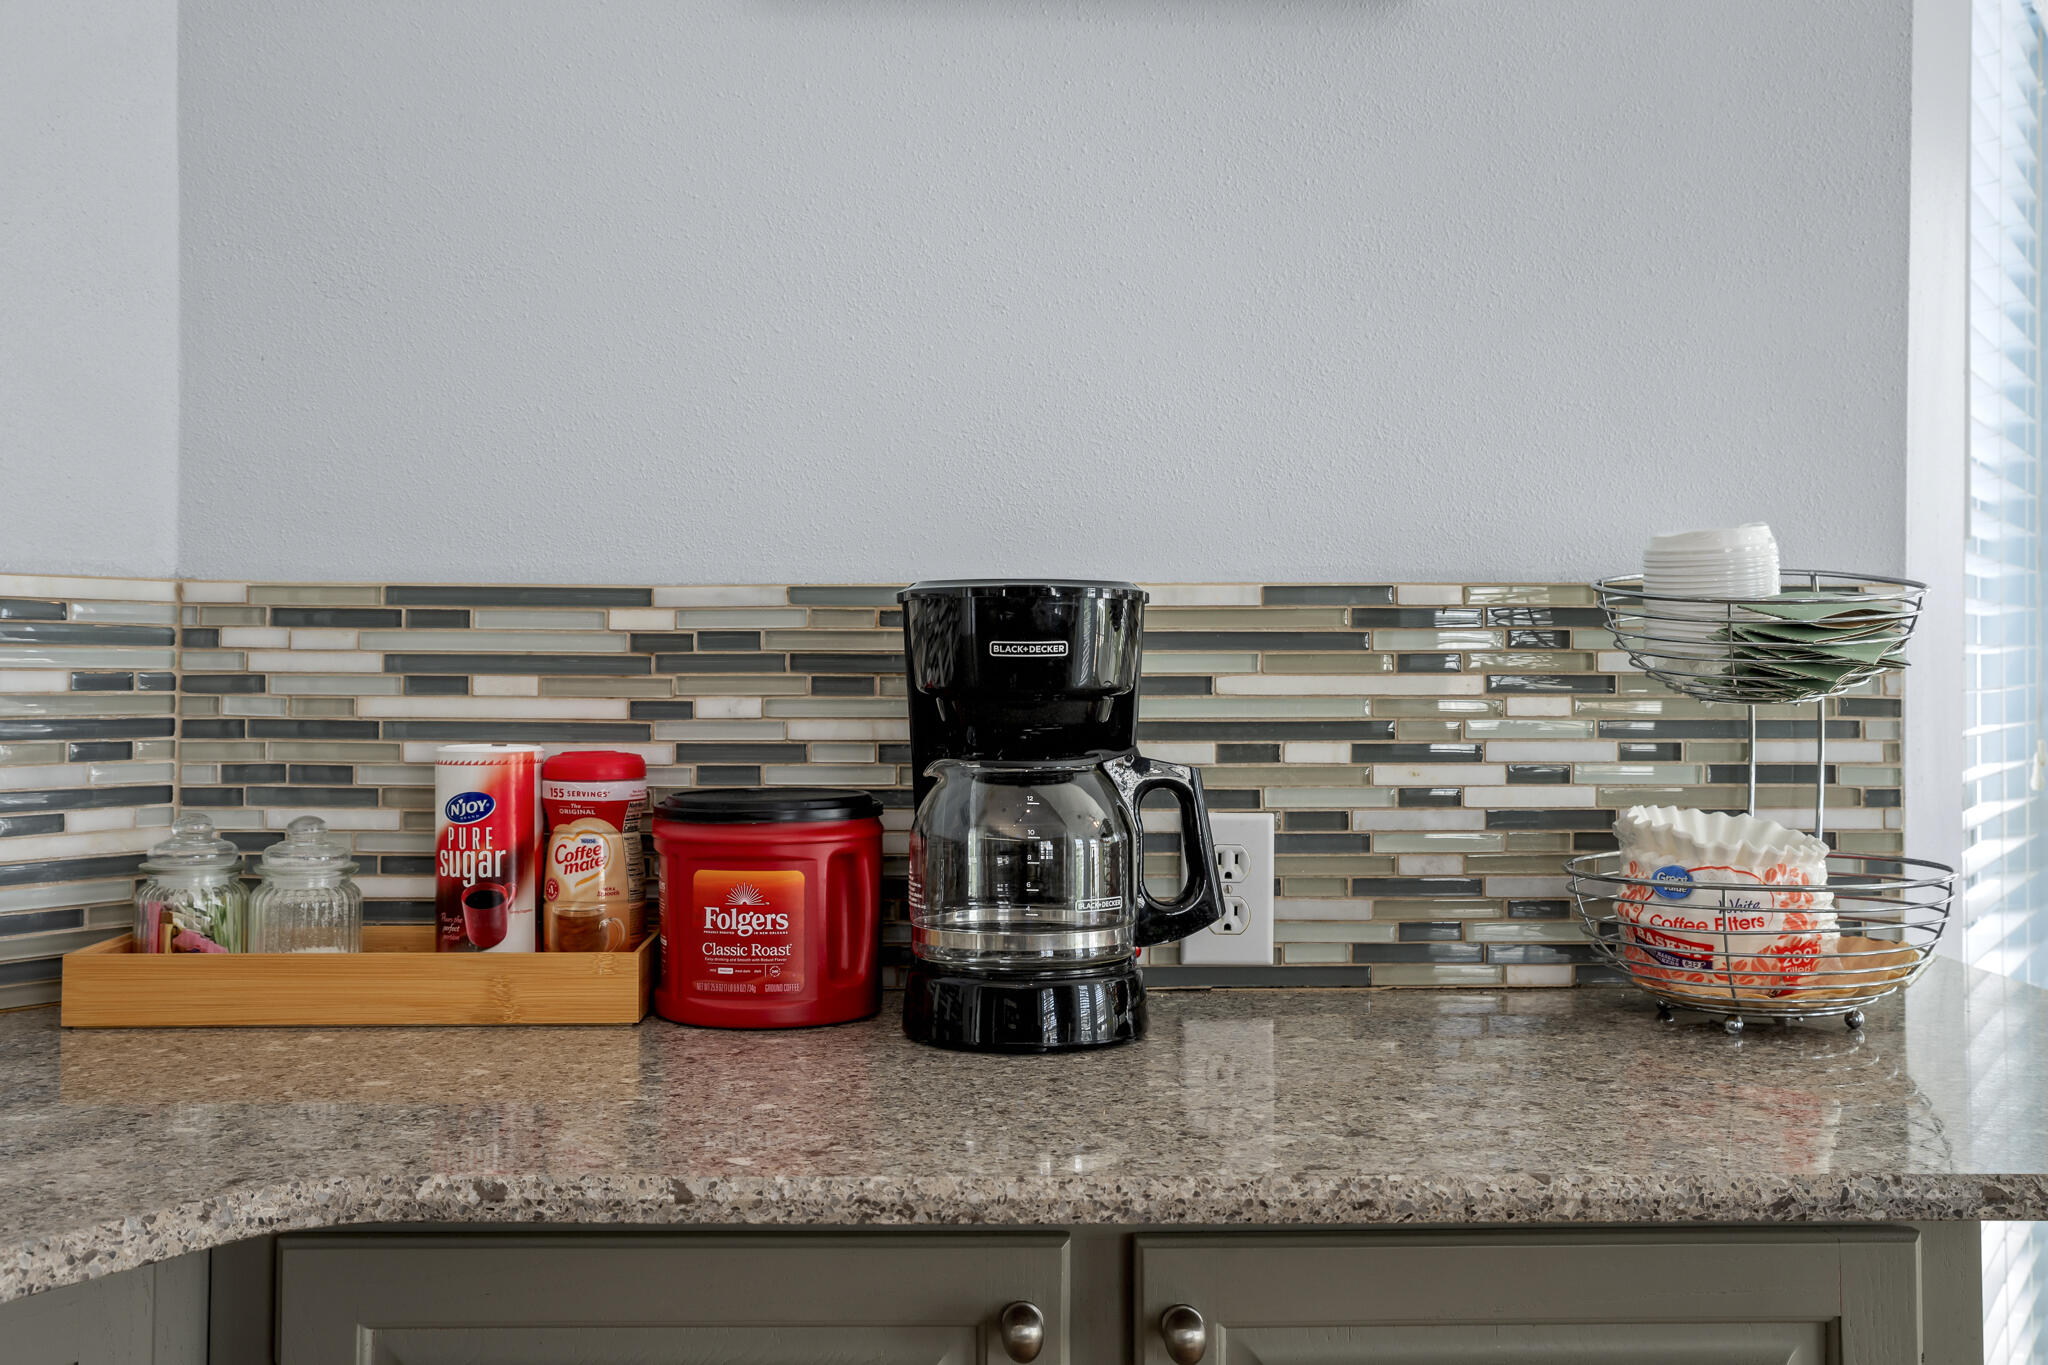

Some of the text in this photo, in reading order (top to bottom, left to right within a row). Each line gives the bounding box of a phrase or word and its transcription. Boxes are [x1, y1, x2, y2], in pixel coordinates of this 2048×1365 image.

[993, 645, 1065, 653] BLACK+DECKER
[550, 788, 564, 798] 155
[448, 827, 493, 850] PURE
[555, 844, 601, 864] Coffee
[440, 849, 506, 888] sugar
[564, 856, 605, 875] mate
[1078, 900, 1120, 910] BLACK+DECKER
[703, 906, 789, 937] Folgers
[1650, 914, 1765, 931] Coffee Flters
[702, 942, 791, 956] Classic Roast
[1637, 927, 1705, 958] BASKET
[1783, 948, 1812, 967] 200
